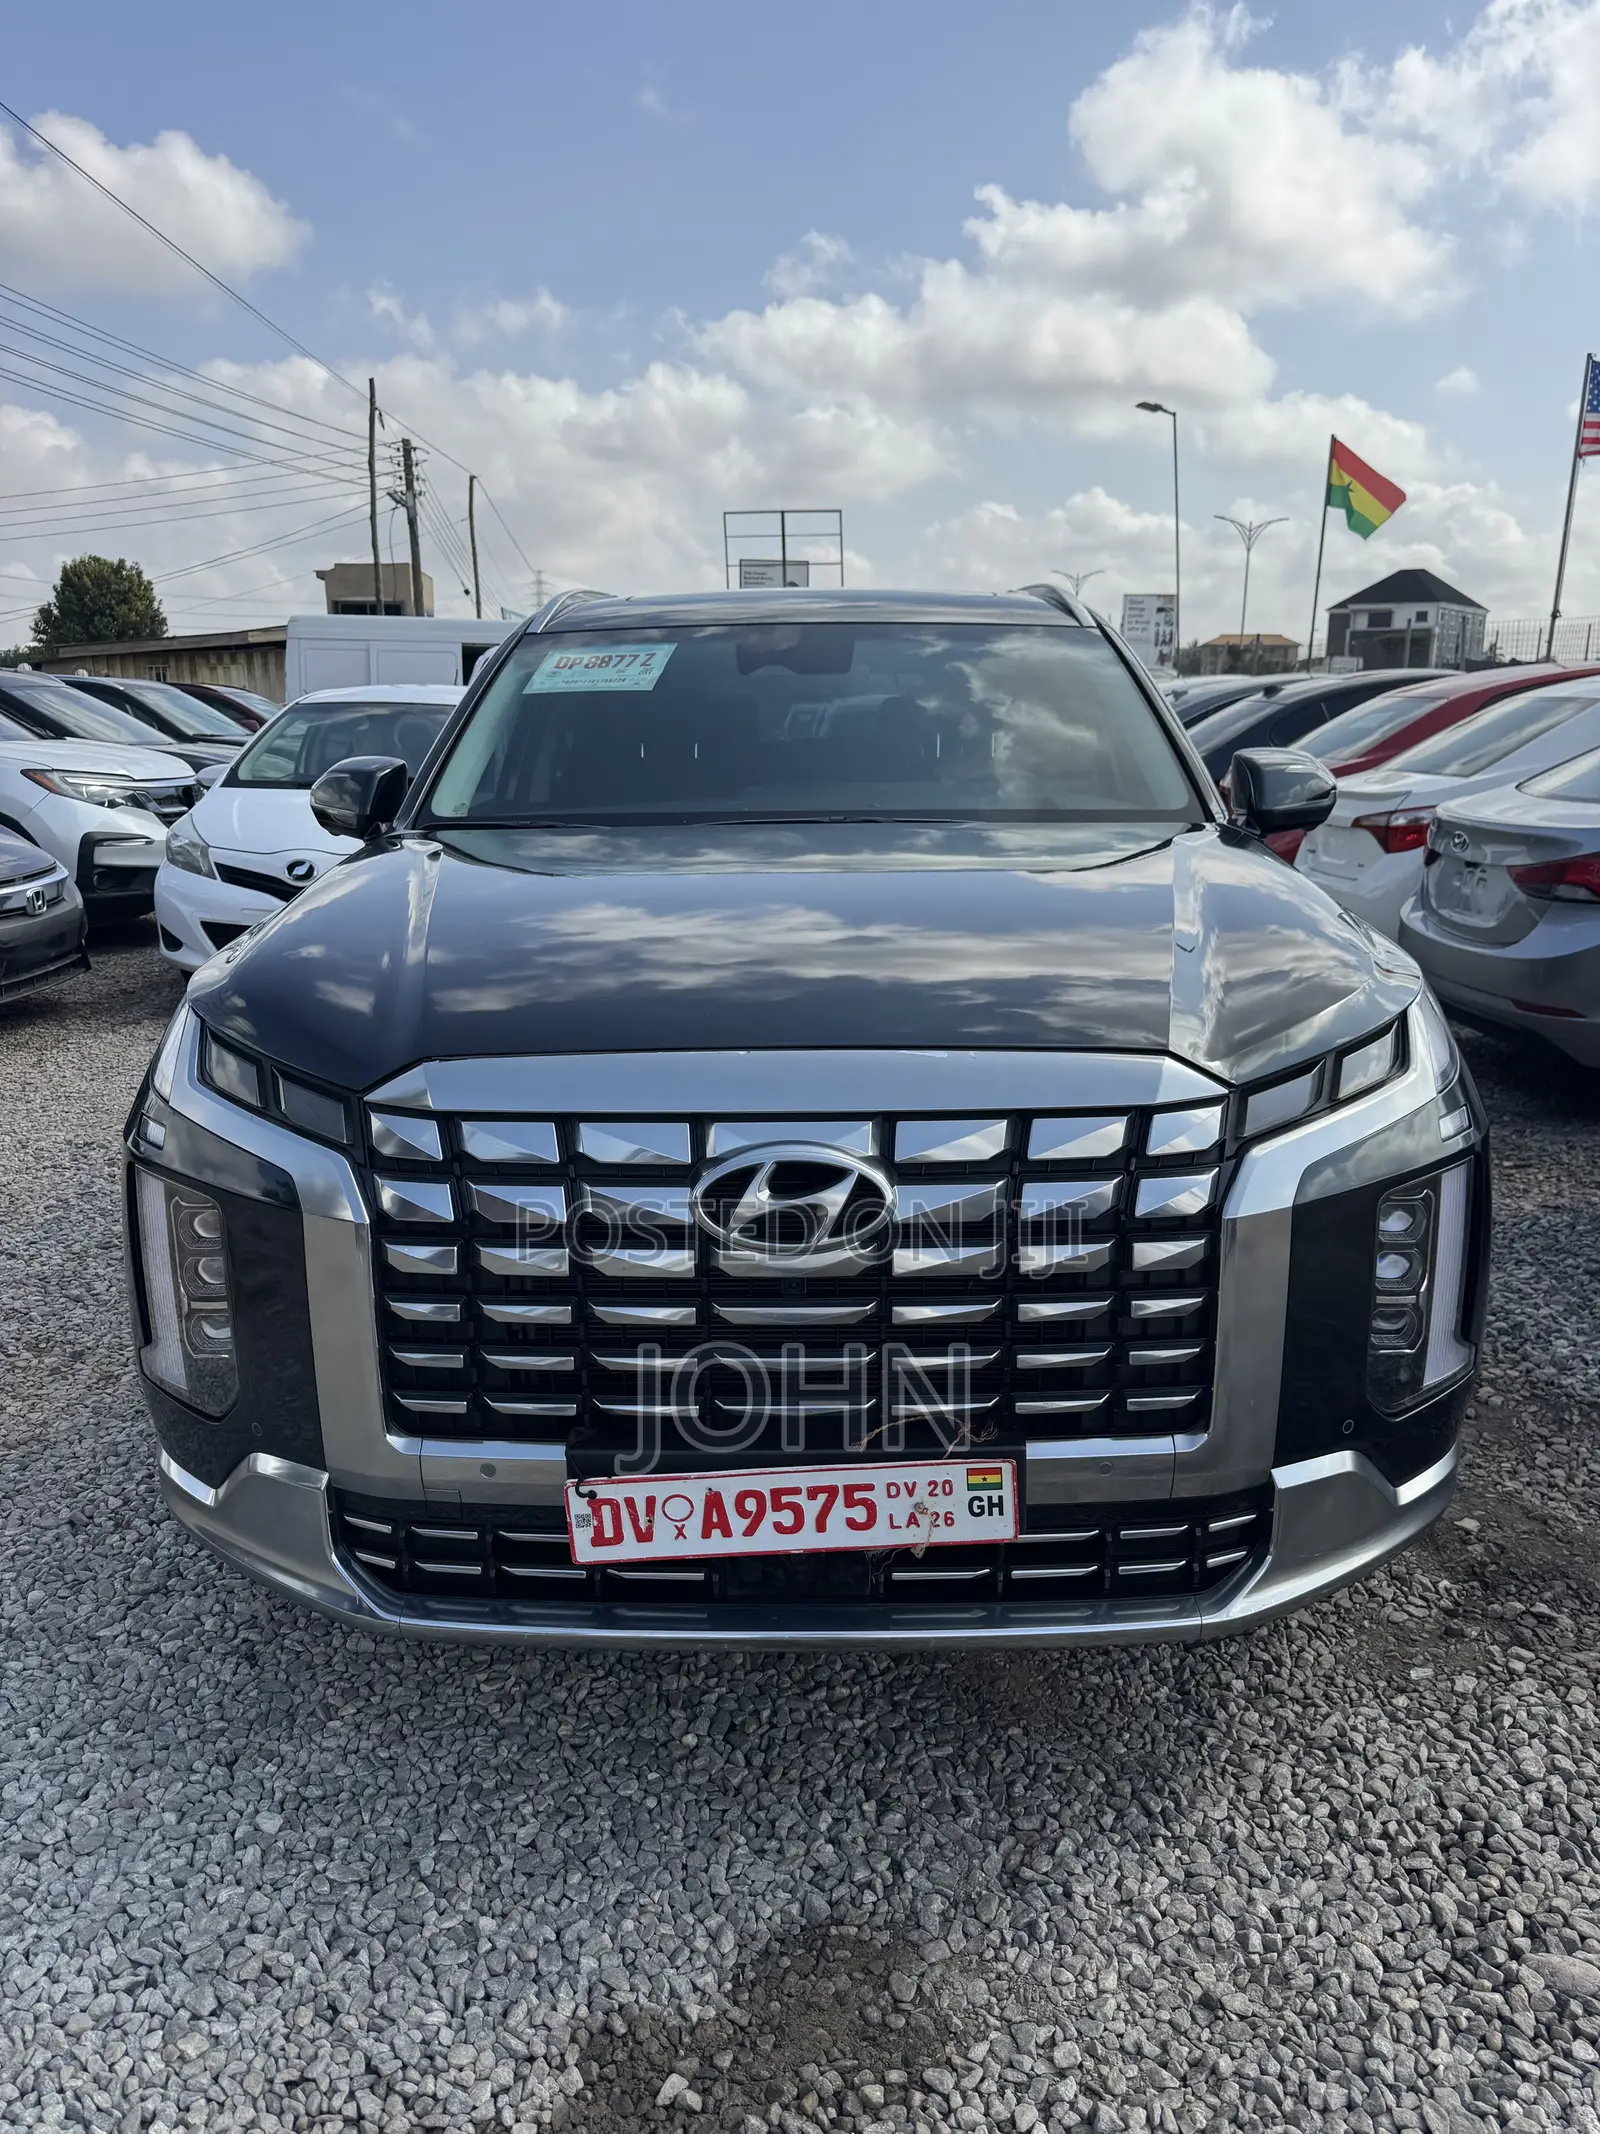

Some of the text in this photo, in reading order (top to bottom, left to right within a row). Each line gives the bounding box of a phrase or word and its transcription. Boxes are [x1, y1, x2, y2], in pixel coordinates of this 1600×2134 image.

[554, 656, 584, 669] DP
[584, 653, 640, 669] 8877
[886, 1479, 953, 1499] DV 20
[587, 1495, 657, 1547] DV
[701, 1483, 878, 1540] A9575
[967, 1495, 1005, 1518] GH
[888, 1511, 955, 1530] LA 26
